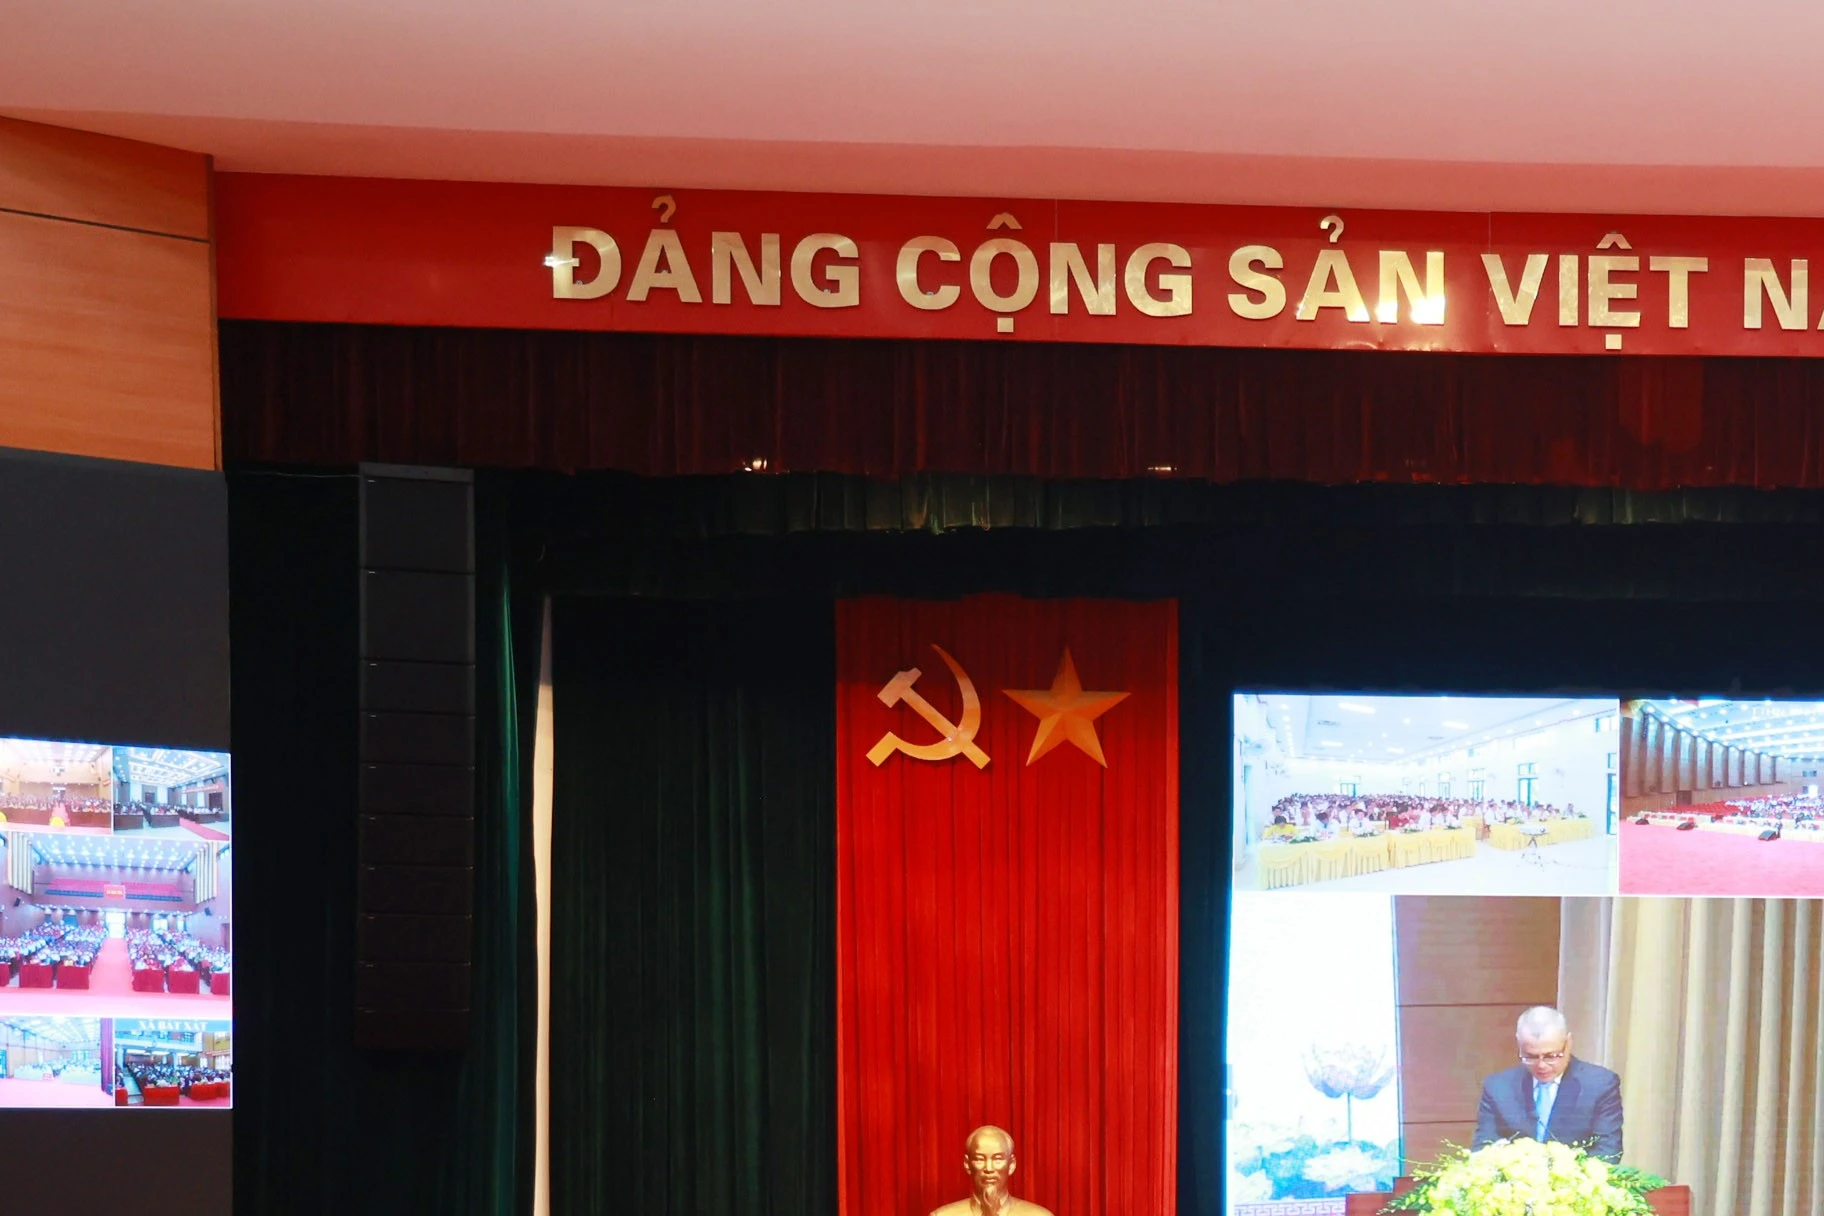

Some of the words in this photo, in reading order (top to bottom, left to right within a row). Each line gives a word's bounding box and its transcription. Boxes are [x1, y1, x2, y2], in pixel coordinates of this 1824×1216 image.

[547, 194, 860, 308] ĐẢNG
[896, 212, 1193, 333] CỘNG
[1227, 215, 1446, 325] SẢN
[1481, 233, 1708, 350] VIỆT
